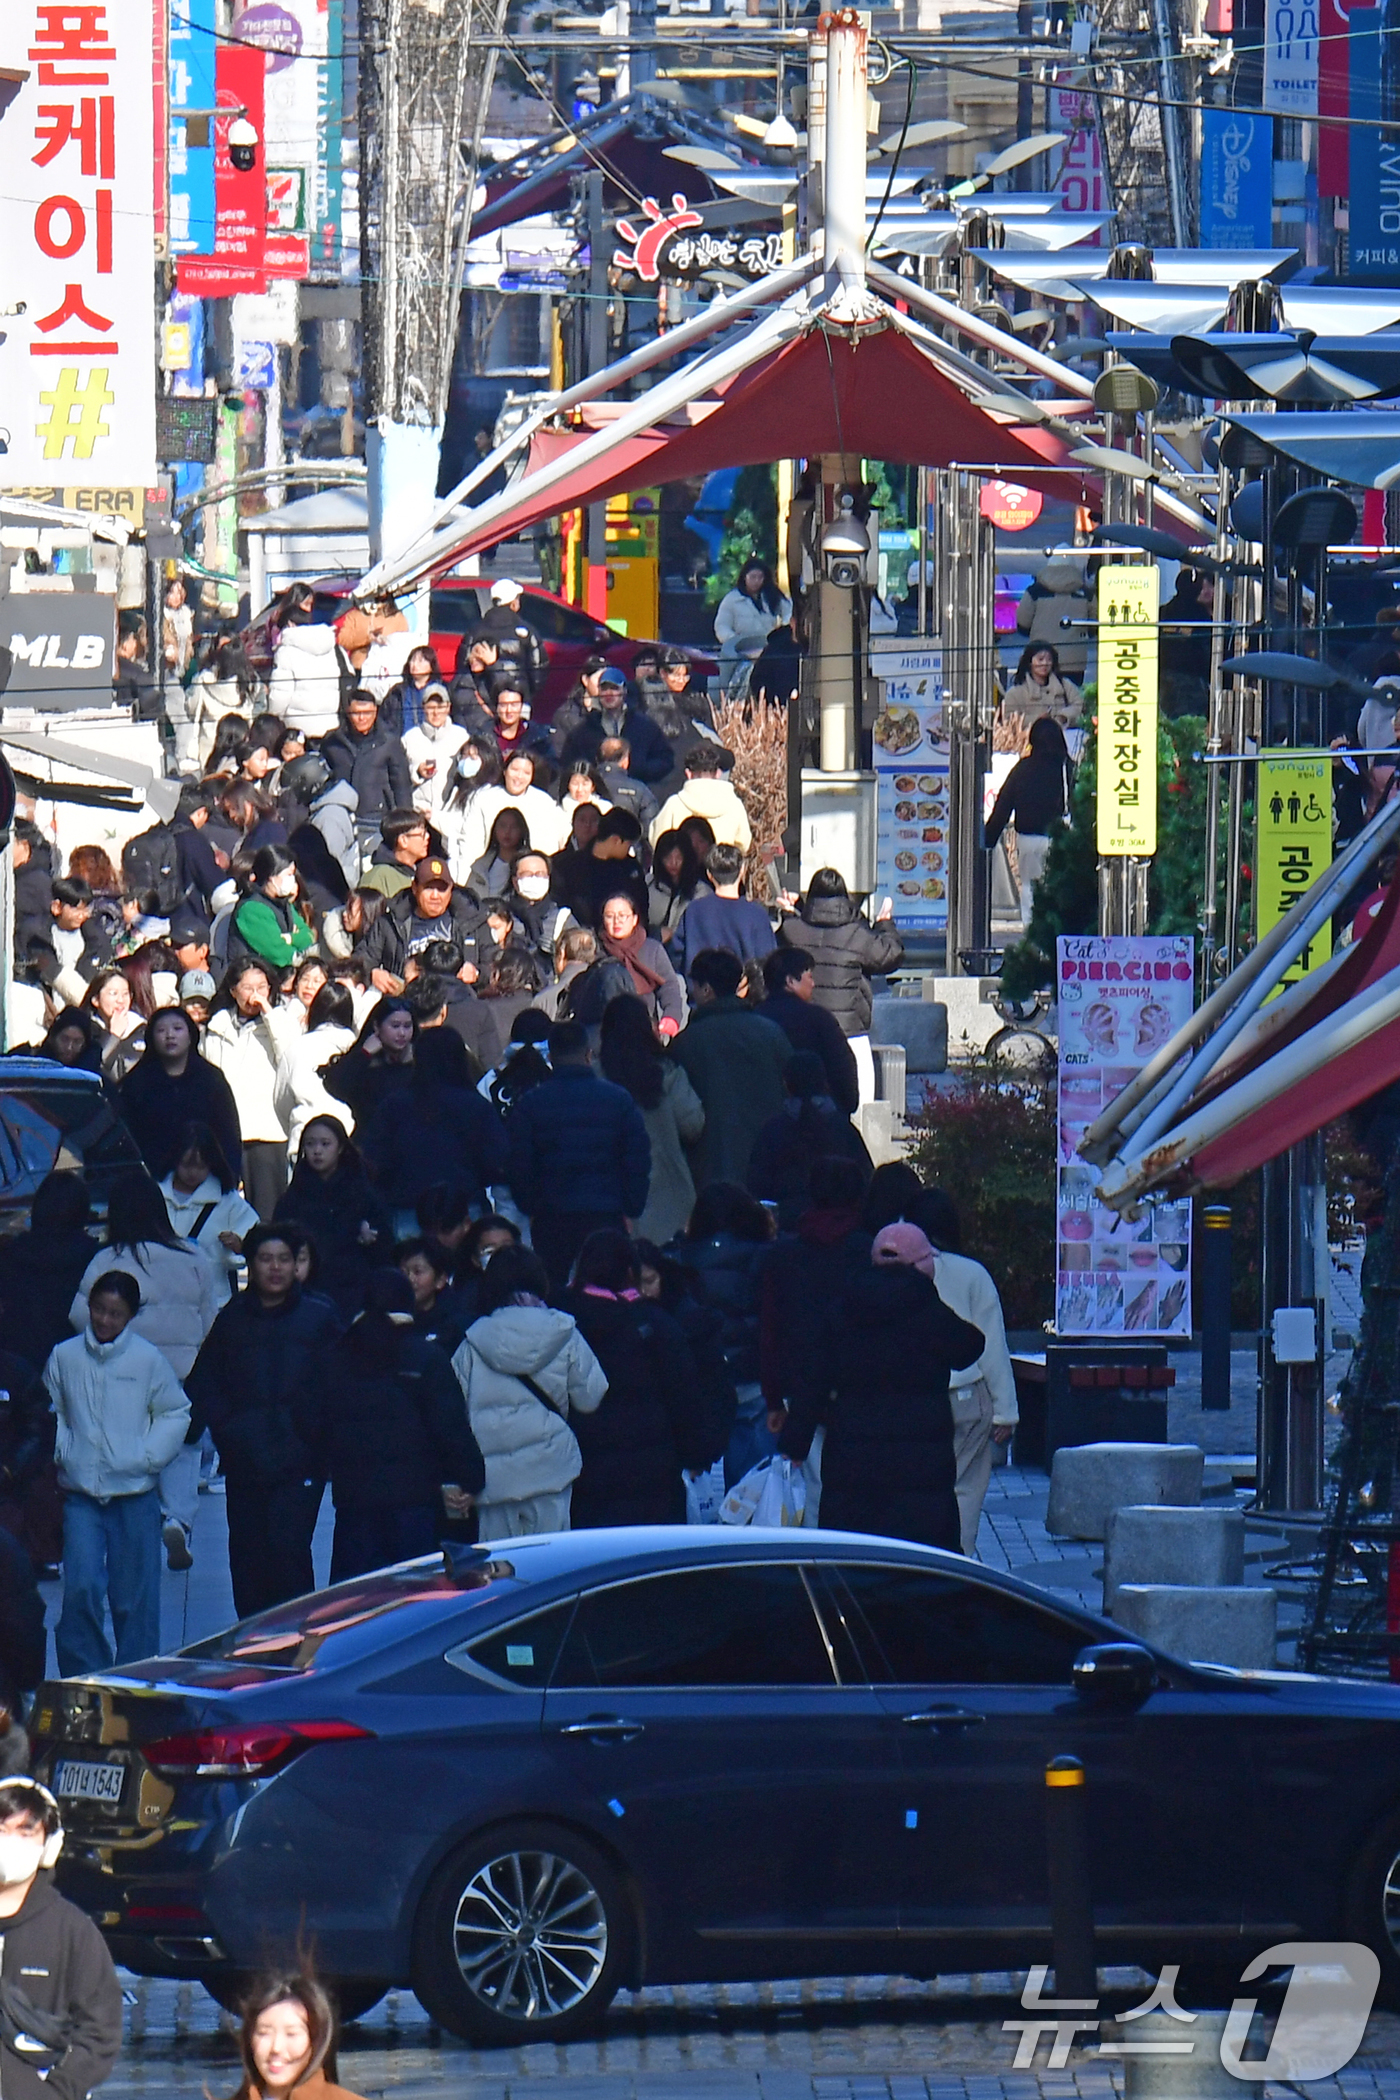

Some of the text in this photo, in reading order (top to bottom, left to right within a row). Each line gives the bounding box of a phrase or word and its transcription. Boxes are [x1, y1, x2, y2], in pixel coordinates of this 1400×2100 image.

[75, 489, 135, 512] ERA
[9, 633, 106, 669] MLB
[1112, 640, 1142, 807] 공중화장실
[1060, 960, 1192, 982] PIERCING
[1065, 1053, 1090, 1065] CATS
[92, 1767, 121, 1797] 1543
